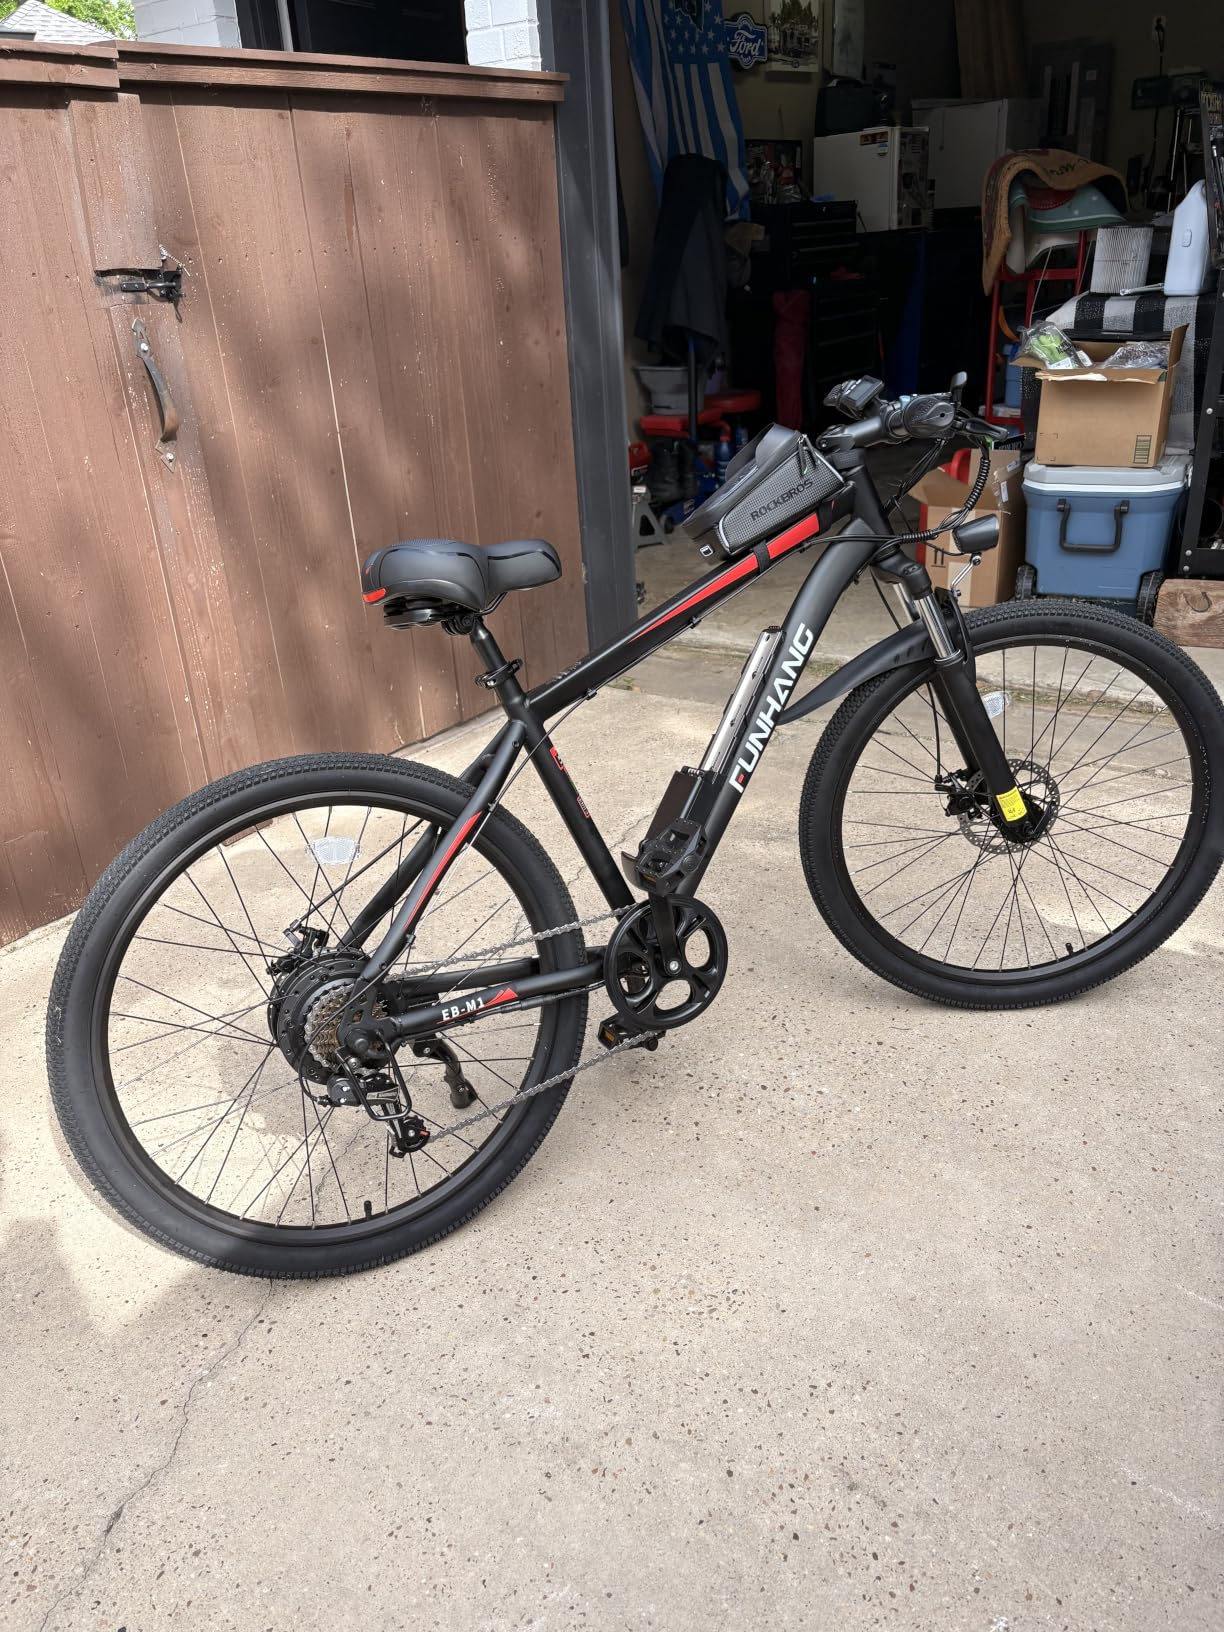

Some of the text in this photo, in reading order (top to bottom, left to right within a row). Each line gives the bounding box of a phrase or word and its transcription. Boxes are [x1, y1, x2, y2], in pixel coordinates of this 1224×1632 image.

[730, 30, 761, 57] Ford
[750, 478, 813, 521] ROCKBROS
[728, 622, 814, 794] FUNHANG
[442, 997, 485, 1021] EB-M1
